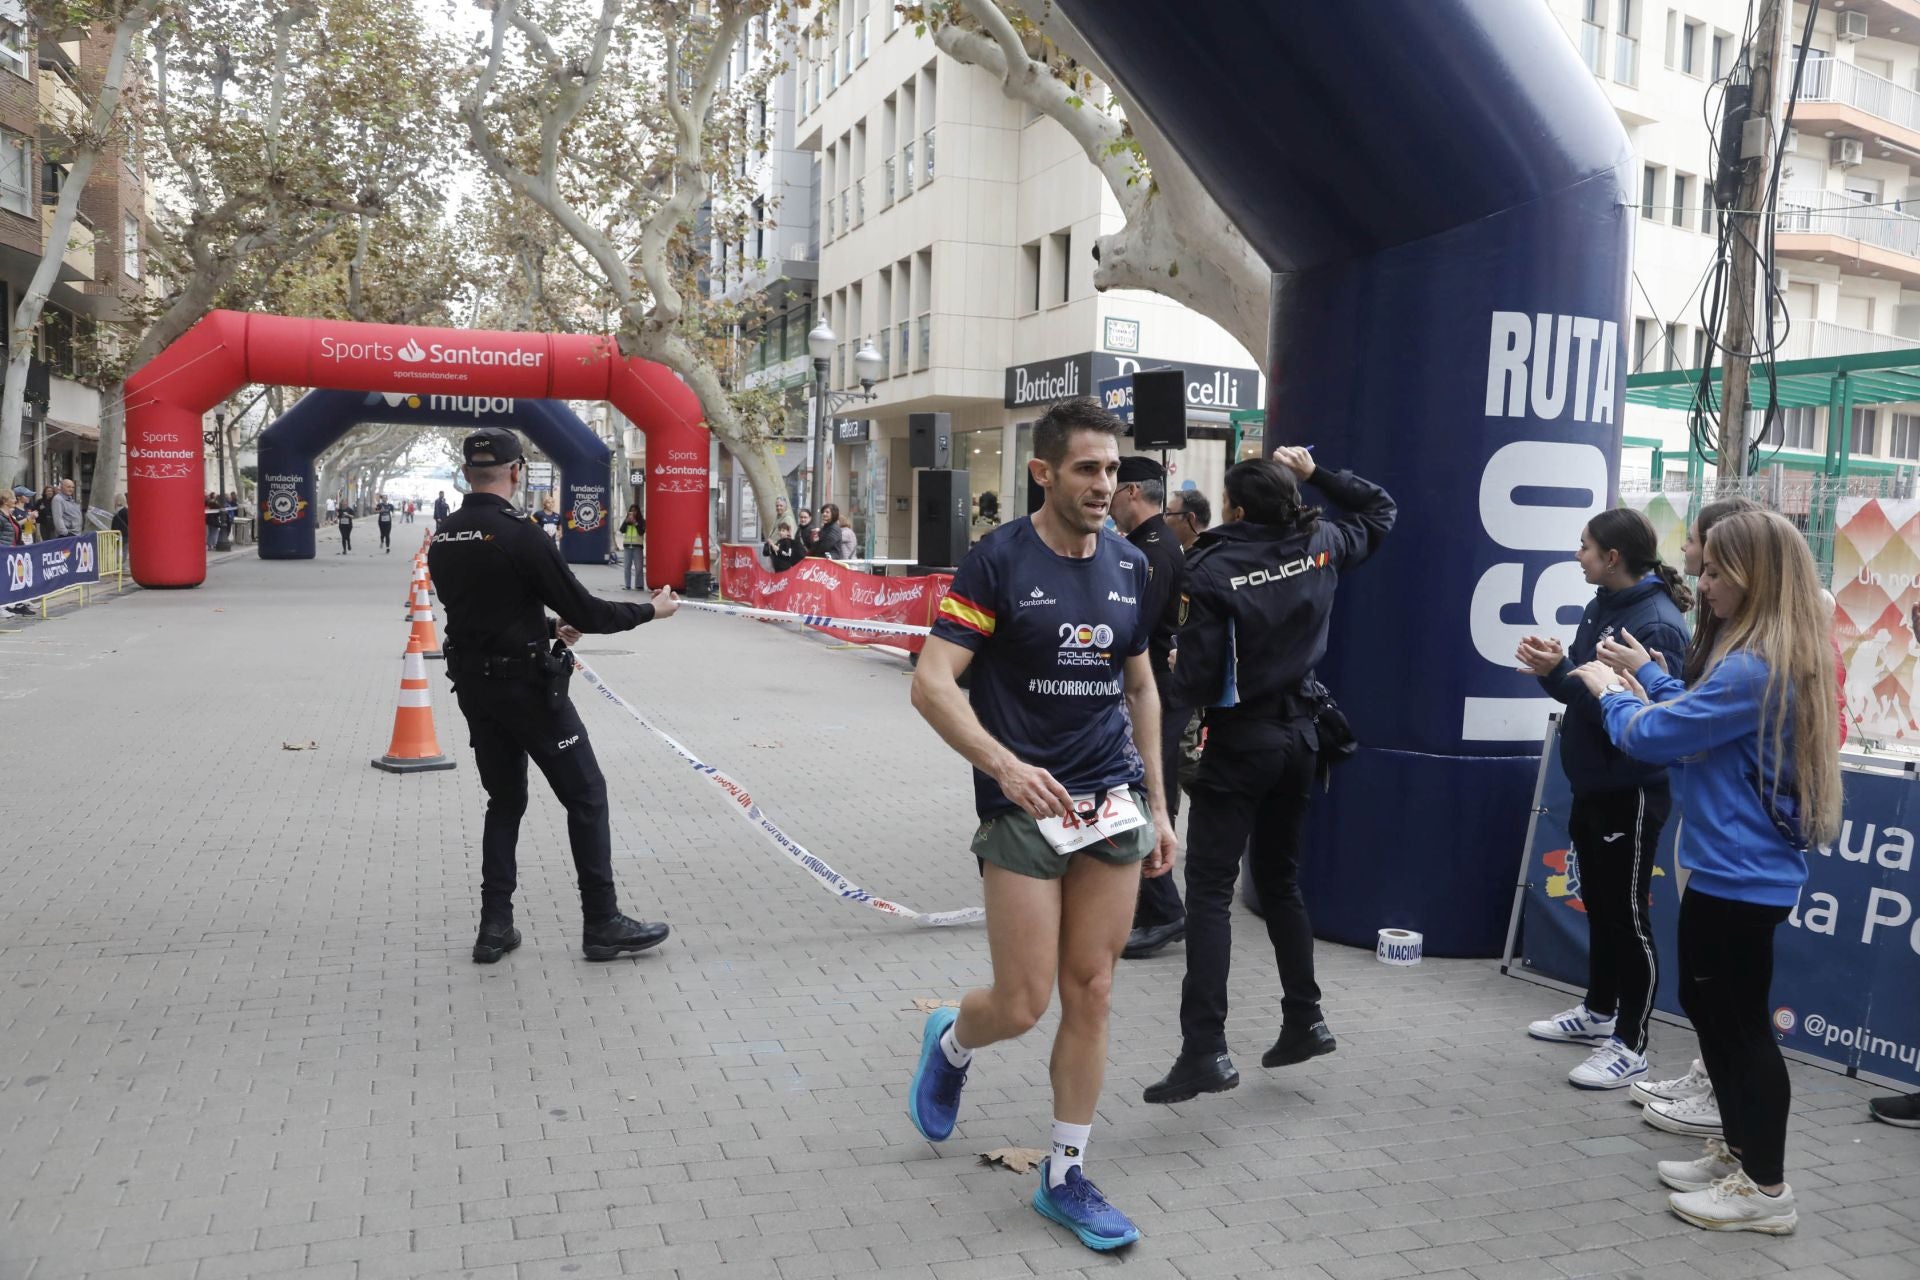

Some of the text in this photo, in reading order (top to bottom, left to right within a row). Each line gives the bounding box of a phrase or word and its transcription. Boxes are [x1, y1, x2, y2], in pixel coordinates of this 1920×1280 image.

[321, 337, 544, 367] Sports Santander
[1485, 311, 1618, 425] RUTA
[393, 370, 468, 381] sportssantander.es
[1014, 360, 1079, 404] Botticelli
[142, 431, 179, 443] Sports
[475, 440, 490, 449] CNP
[140, 448, 194, 460] Santander
[668, 450, 698, 461] Sports
[665, 465, 708, 476] Santander
[265, 474, 303, 483] fundación
[270, 482, 296, 491] mupol
[570, 484, 605, 493] fundación
[575, 492, 599, 501] mupol
[431, 530, 483, 543] POLICIA
[1230, 555, 1316, 590] POLICIA
[1019, 598, 1056, 607] Santander
[1058, 622, 1114, 649] 200
[1058, 651, 1101, 659] POLICIA
[558, 735, 580, 749] CNP
